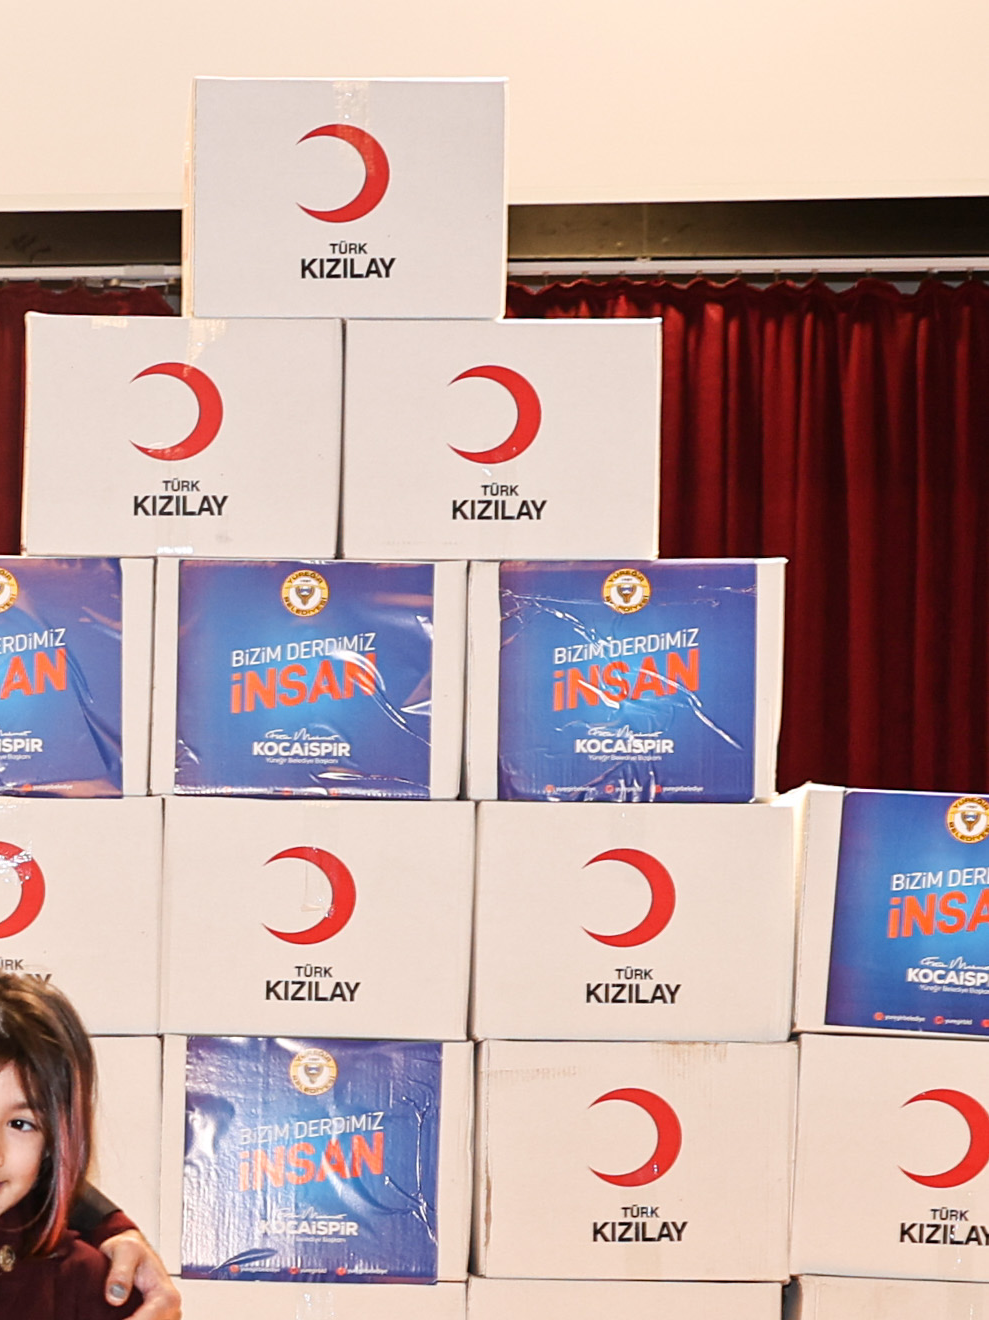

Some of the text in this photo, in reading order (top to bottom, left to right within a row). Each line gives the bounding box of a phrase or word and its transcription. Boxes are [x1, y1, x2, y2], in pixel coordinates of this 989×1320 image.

[329, 241, 368, 255] TÜRK
[300, 257, 396, 279] KIZILAY
[162, 478, 200, 492] TÜRK
[480, 482, 519, 497] TÜRK
[133, 494, 229, 517] KIZILAY
[451, 499, 548, 521] KIZILAY
[294, 965, 333, 978] TÜRK
[614, 967, 654, 980] TÜRK
[265, 979, 361, 1002] KIZILAY
[585, 982, 682, 1005] KIZILAY
[620, 1205, 660, 1219] TÜRK
[930, 1207, 969, 1222] TÜRK
[592, 1221, 688, 1243] KIZILAY
